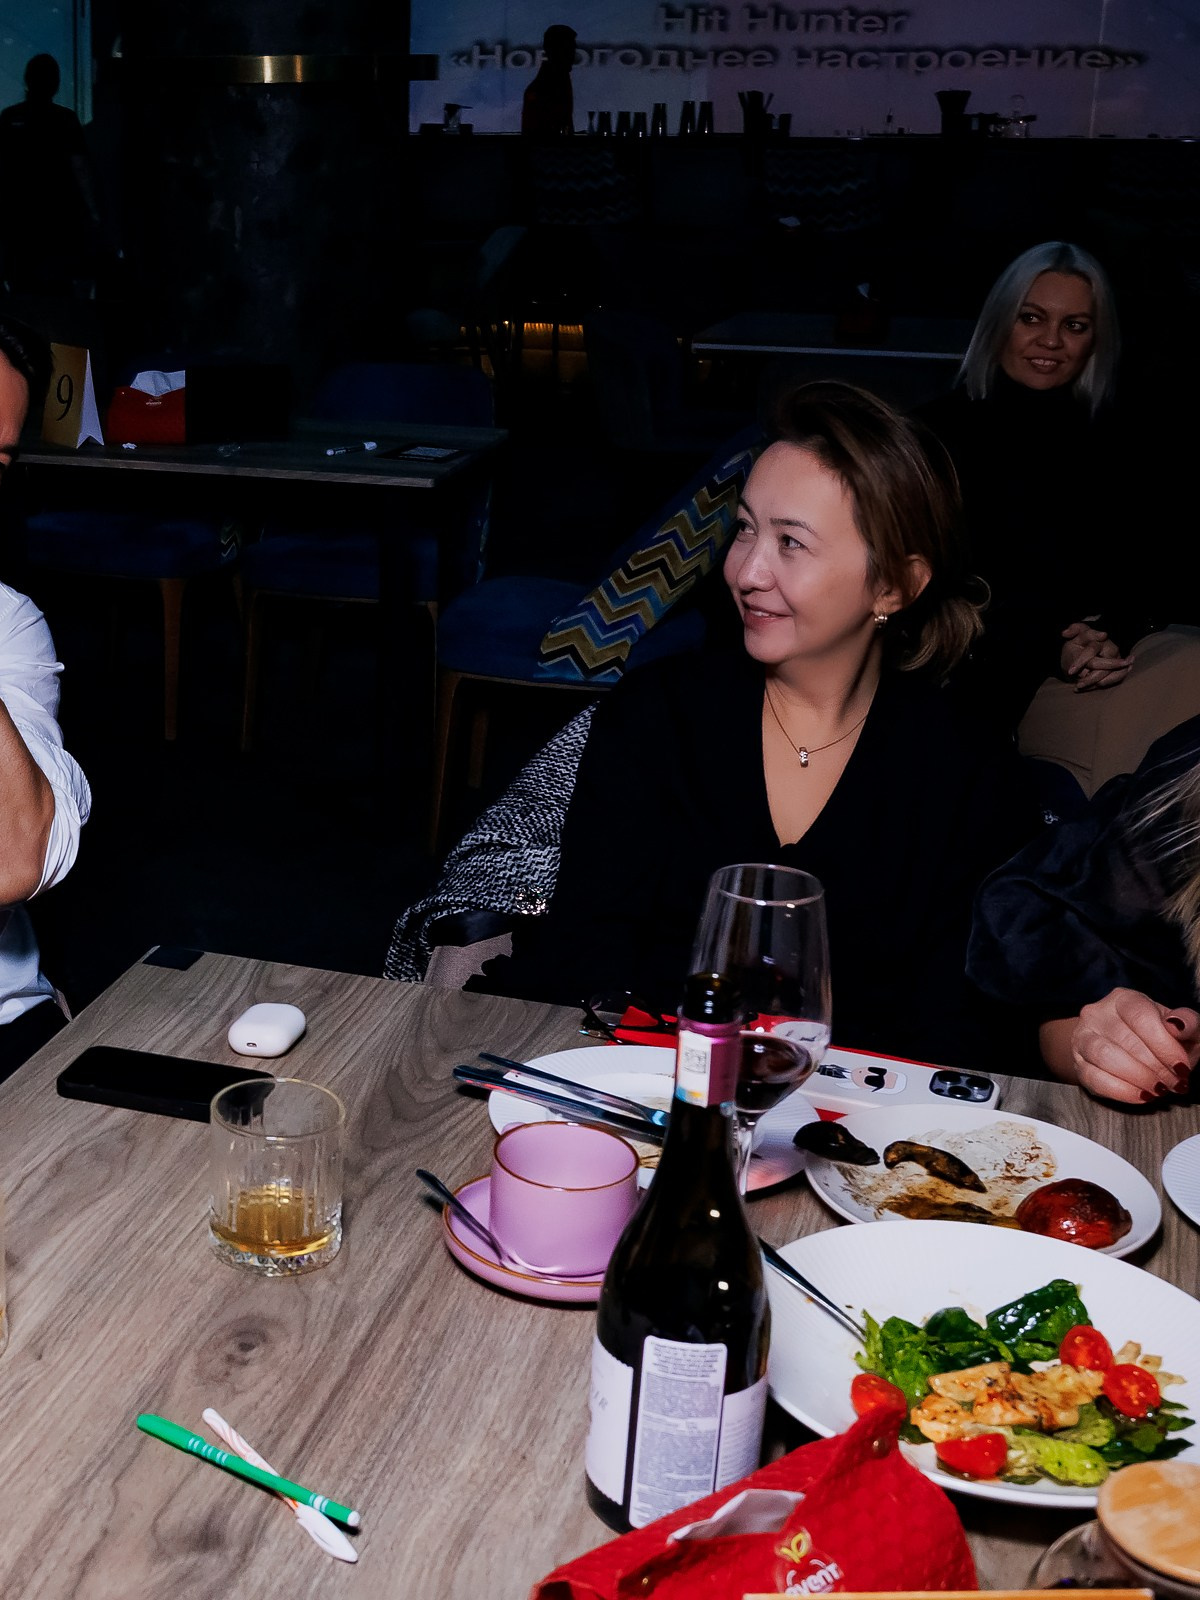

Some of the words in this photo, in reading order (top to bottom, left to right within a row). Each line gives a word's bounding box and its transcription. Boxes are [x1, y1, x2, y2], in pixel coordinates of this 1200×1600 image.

[660, 6, 727, 34] Hit
[747, 4, 908, 35] Hunter
[797, 48, 1142, 74] настроение»
[56, 374, 74, 422] 9
